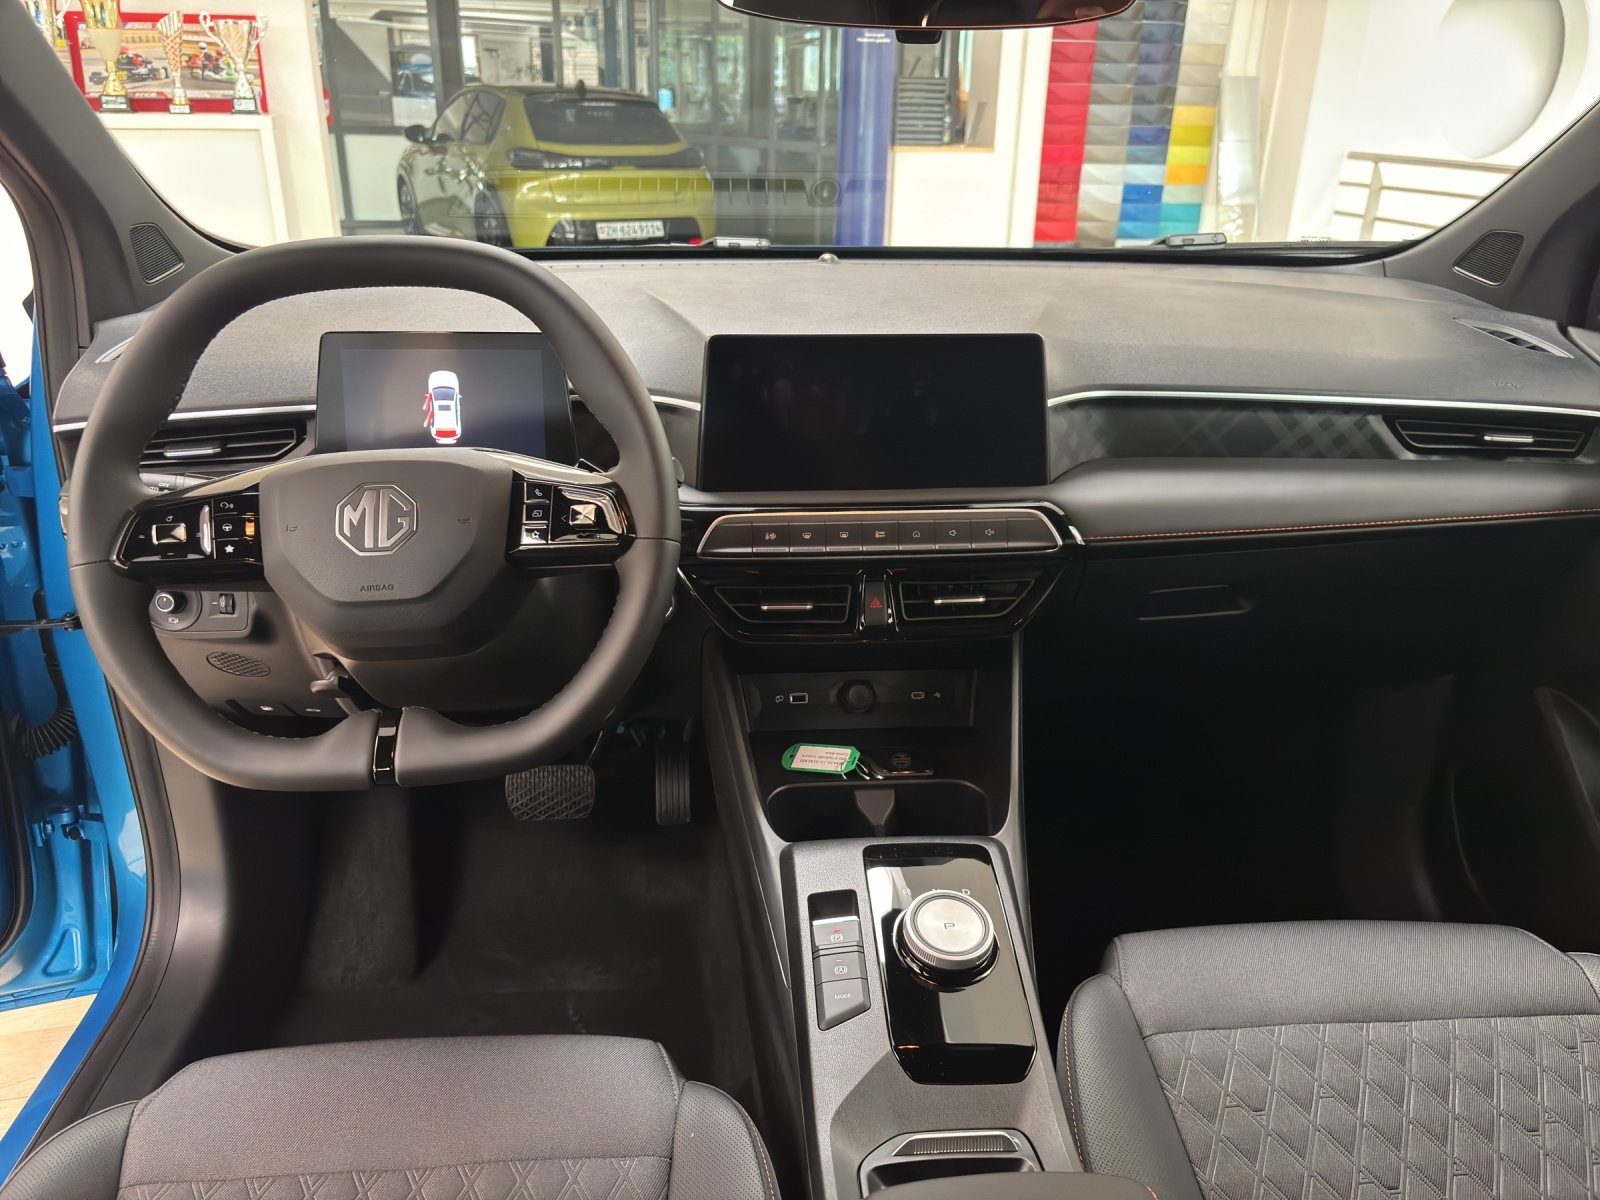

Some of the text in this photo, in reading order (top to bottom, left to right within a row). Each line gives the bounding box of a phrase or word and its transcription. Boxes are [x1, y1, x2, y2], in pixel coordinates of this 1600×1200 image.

[343, 489, 411, 549] MG
[360, 583, 395, 593] AIRBAG
[961, 888, 971, 896] D
[944, 922, 956, 930] P
